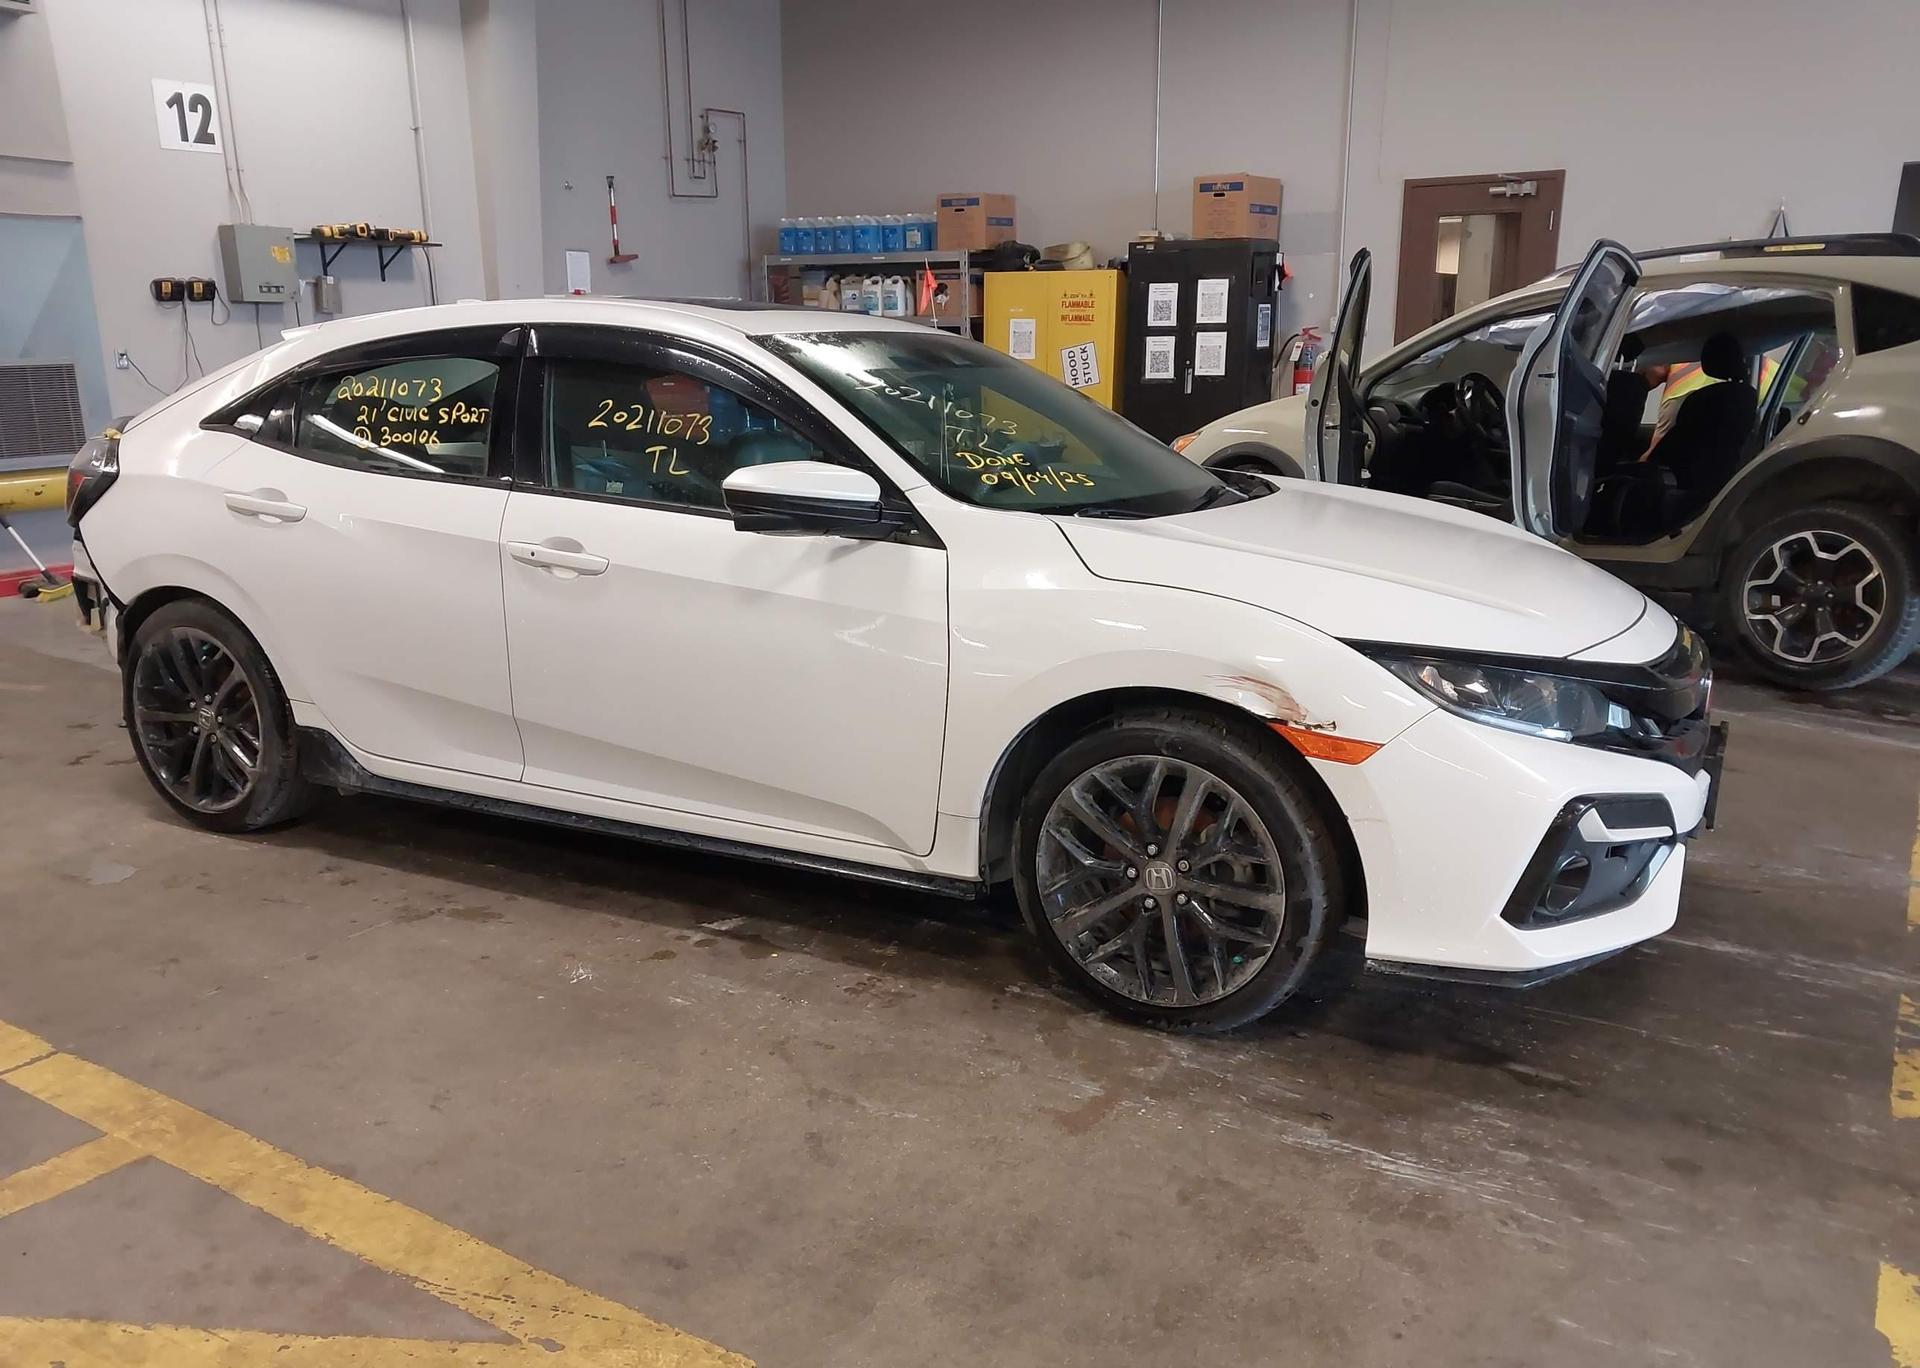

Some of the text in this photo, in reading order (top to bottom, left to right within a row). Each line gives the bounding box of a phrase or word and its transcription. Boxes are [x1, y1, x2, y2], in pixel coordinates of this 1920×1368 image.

[165, 91, 216, 145] 12
[1068, 350, 1080, 386] HOOD
[1079, 345, 1093, 384] STUCK
[337, 376, 442, 402] 20211073
[588, 399, 713, 445] 20211073
[645, 445, 690, 475] TL
[956, 452, 1031, 470] DONE
[981, 466, 1096, 496] 09/04/25
